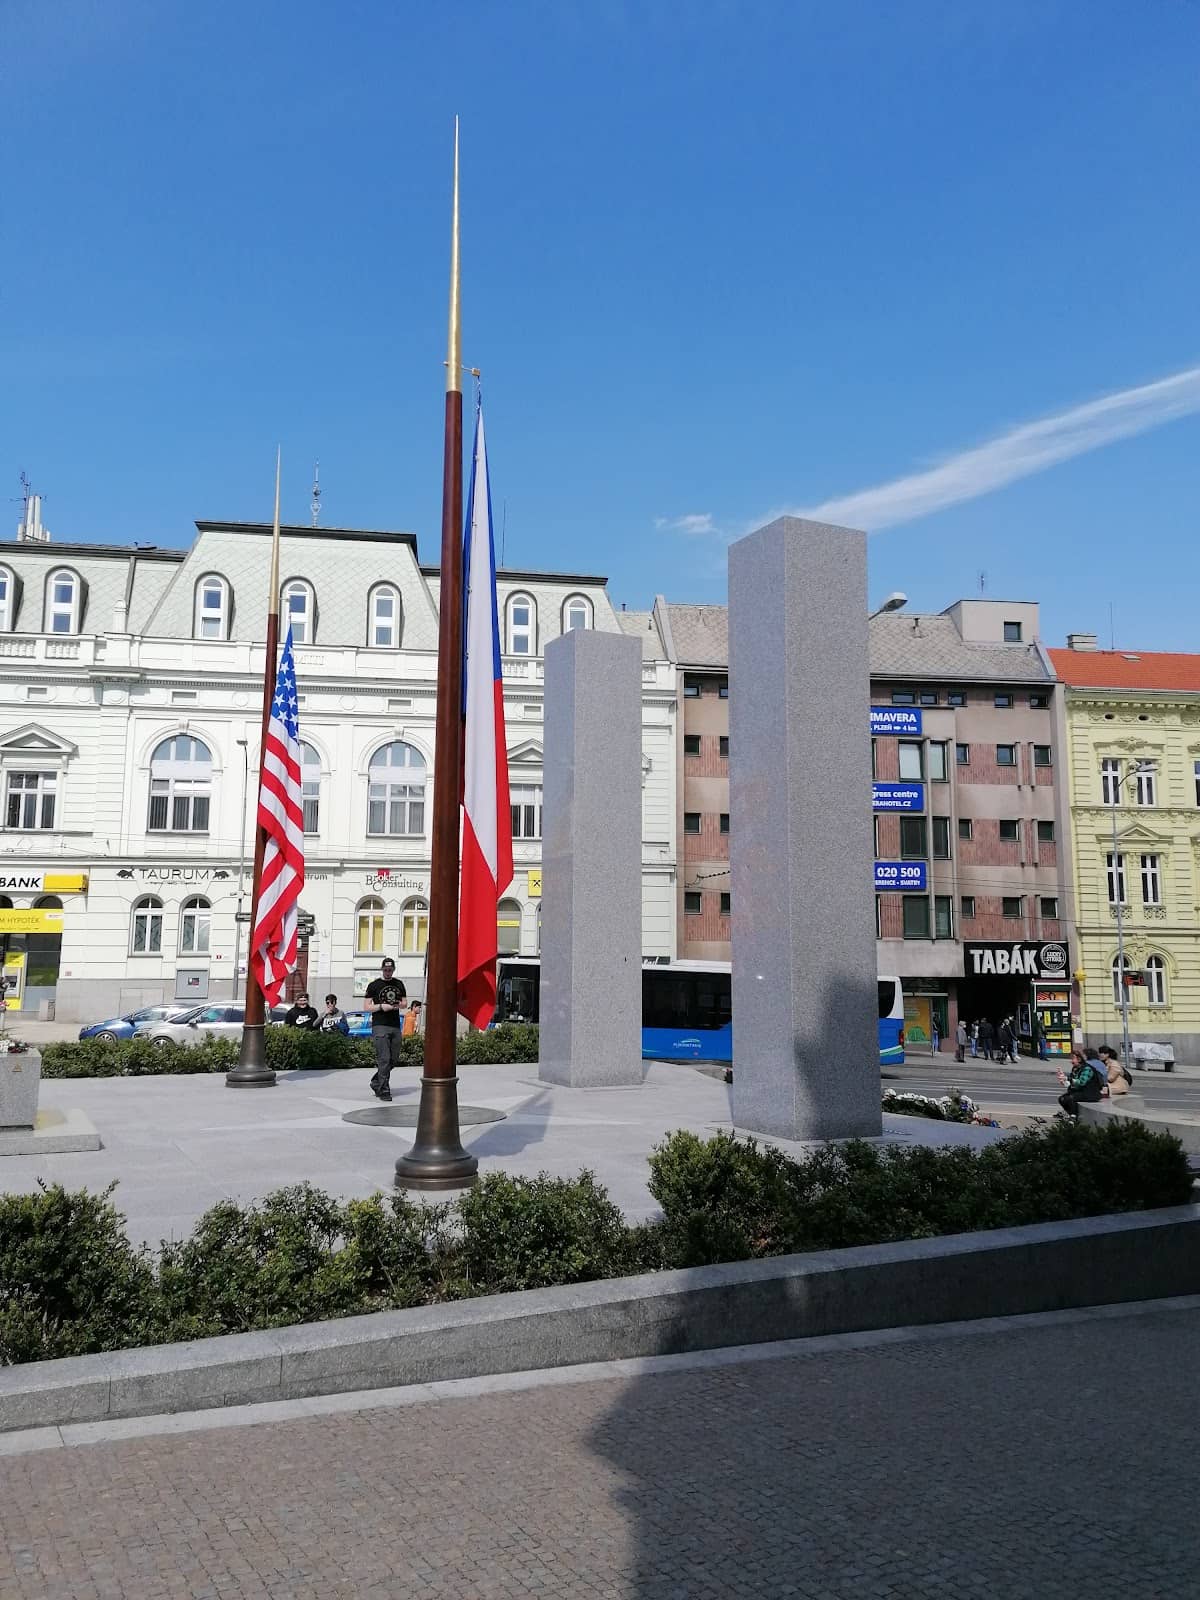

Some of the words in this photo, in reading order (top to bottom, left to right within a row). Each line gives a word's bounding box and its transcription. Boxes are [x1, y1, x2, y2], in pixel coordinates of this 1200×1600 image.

[892, 790, 919, 798] centre
[139, 869, 209, 880] TAURUM
[877, 867, 898, 878] 020
[900, 867, 921, 878] 500
[0, 877, 42, 888] BANK
[373, 879, 424, 892] Consulting
[969, 944, 1039, 975] TABÁK
